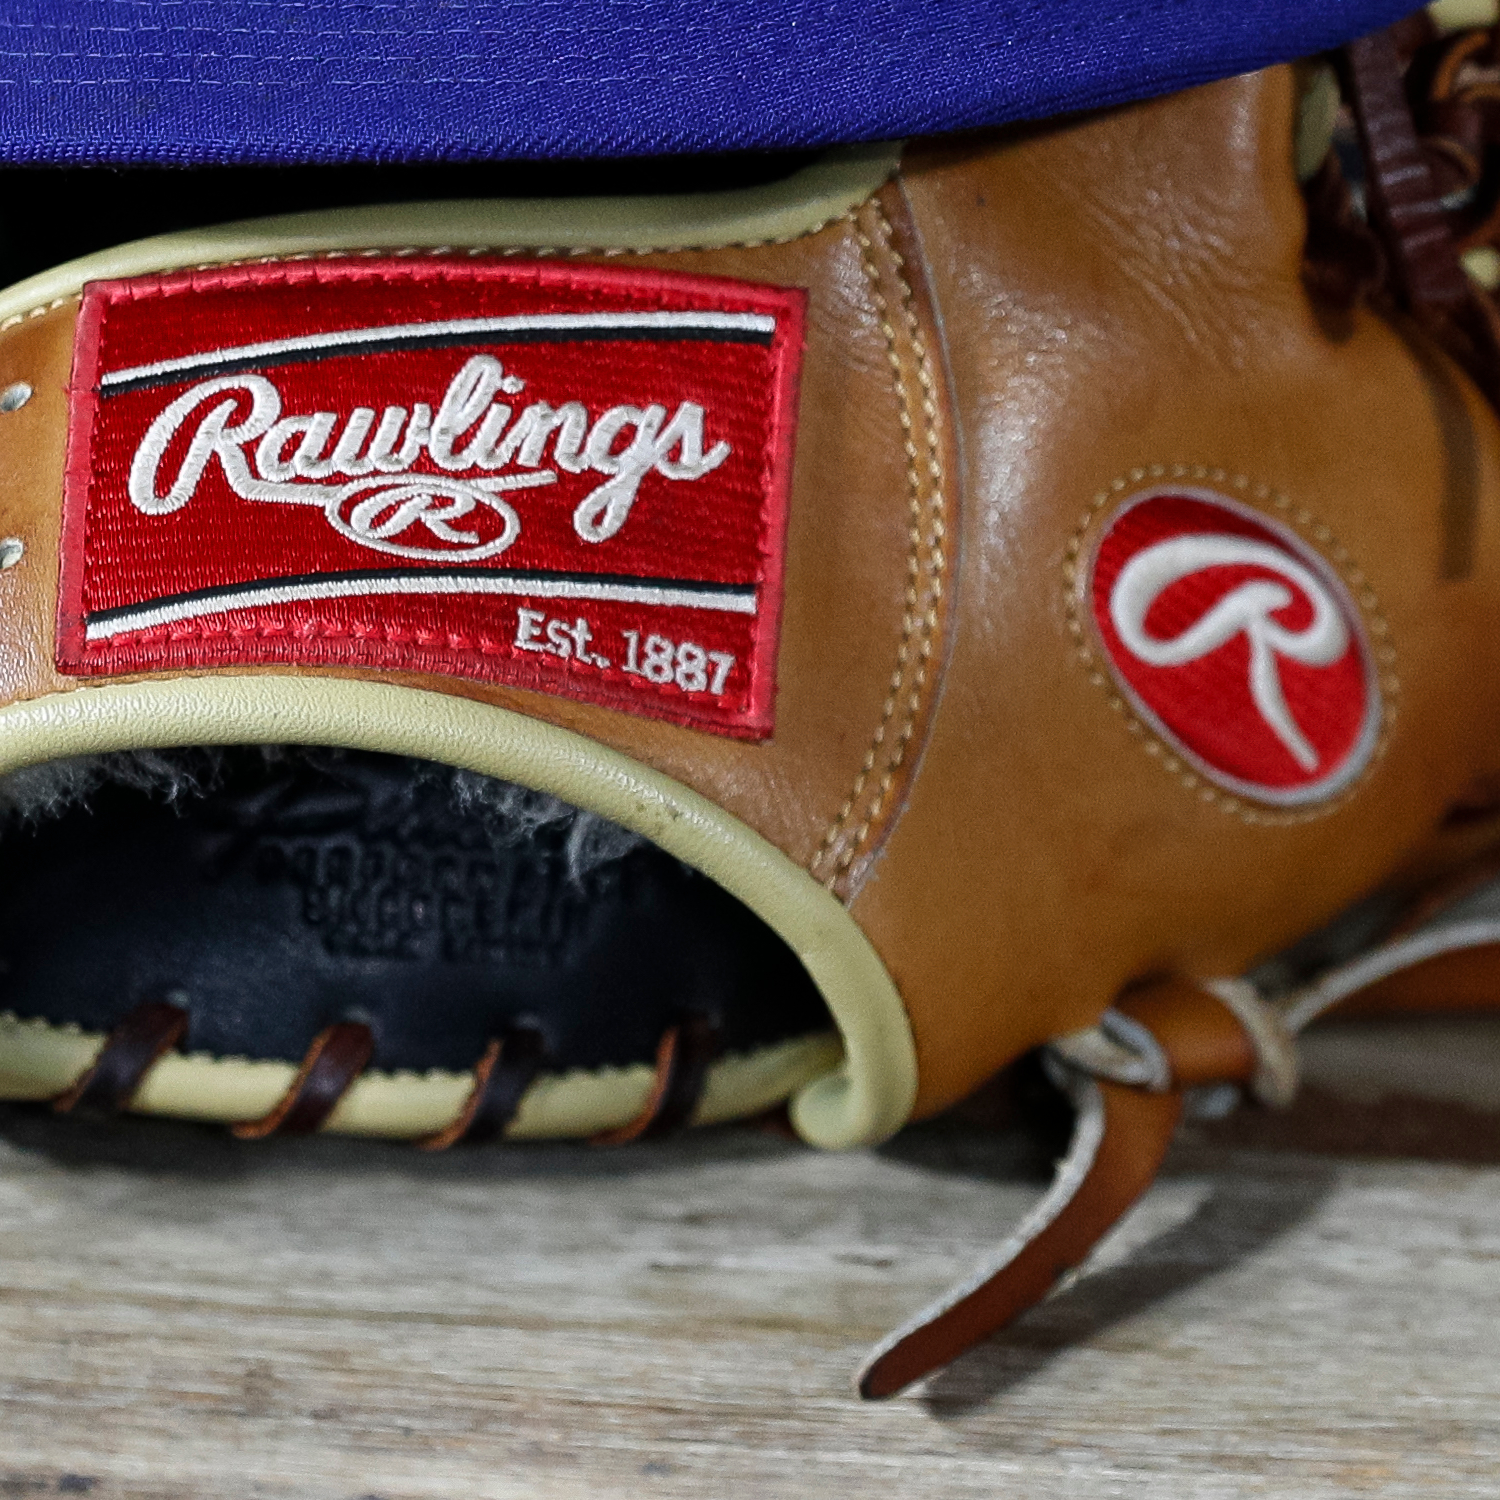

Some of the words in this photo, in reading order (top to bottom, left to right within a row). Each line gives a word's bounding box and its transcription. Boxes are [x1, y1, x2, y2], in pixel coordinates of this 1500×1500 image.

[128, 354, 732, 544] Rawlings
[351, 483, 480, 545] R
[514, 607, 611, 668] Est.
[622, 630, 736, 696] 1887
[1109, 533, 1350, 772] R
